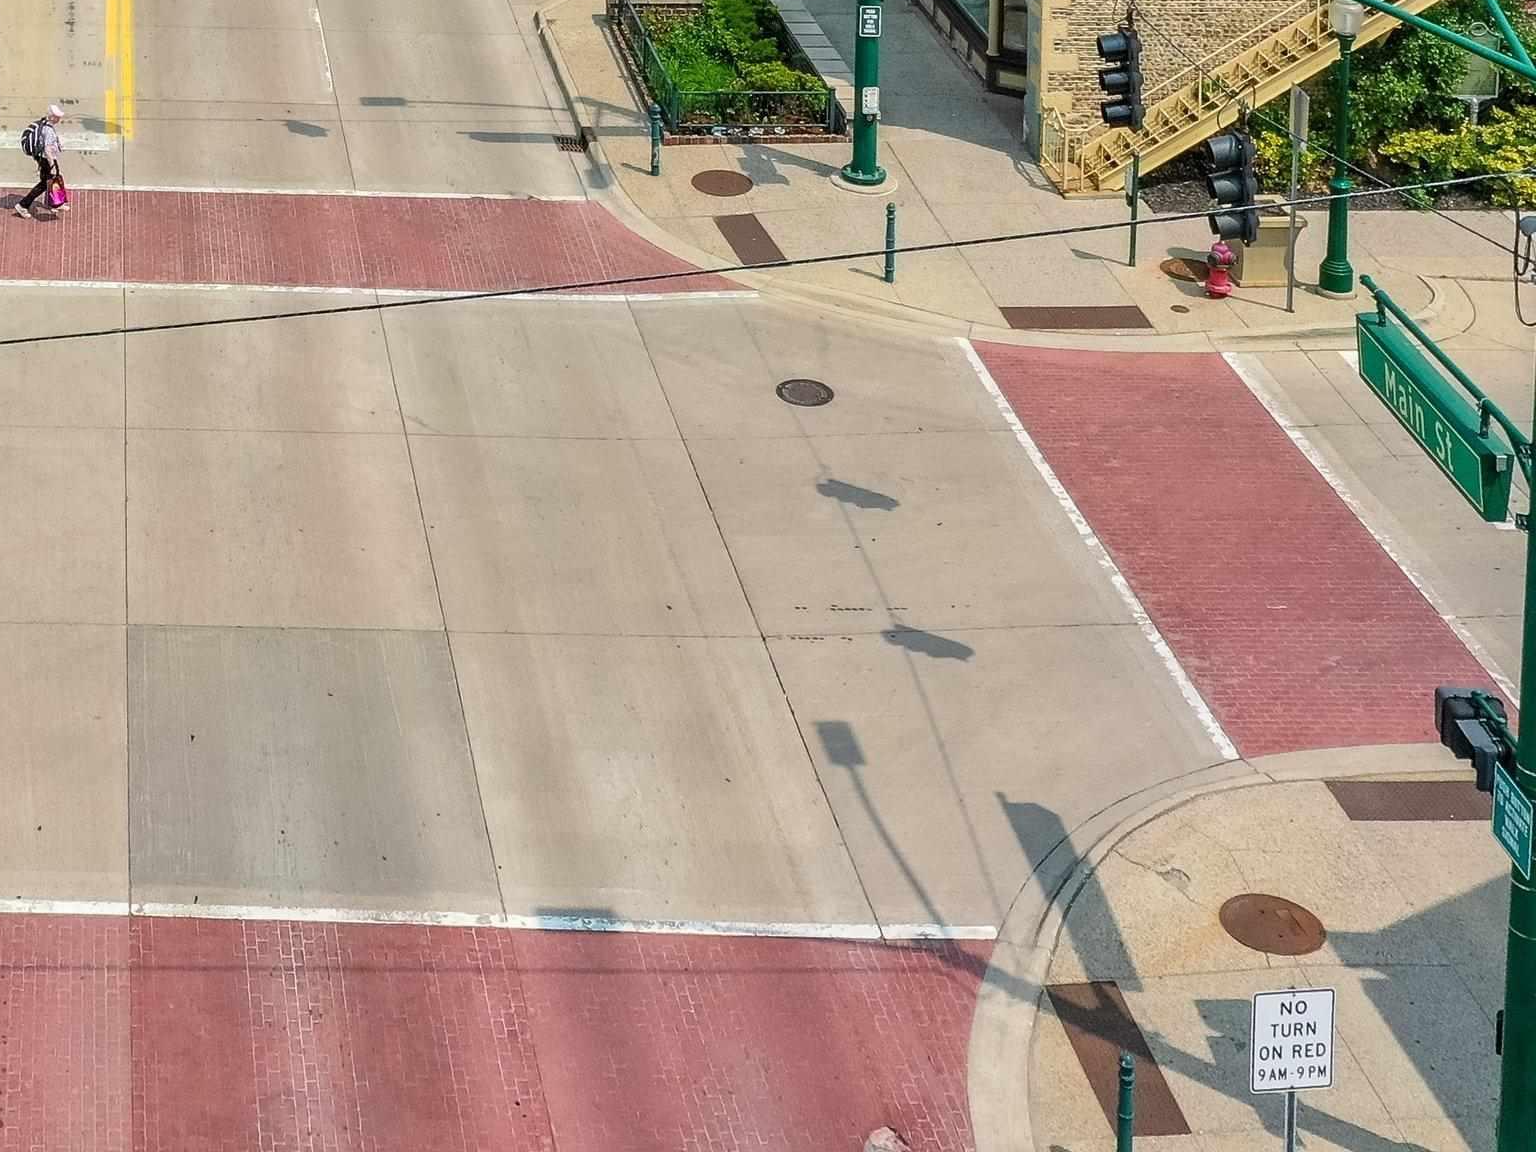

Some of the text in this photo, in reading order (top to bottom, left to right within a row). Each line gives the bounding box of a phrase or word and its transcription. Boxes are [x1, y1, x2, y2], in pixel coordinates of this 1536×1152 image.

[1384, 362, 1454, 472] Main St
[1280, 1001, 1307, 1015] NO
[1271, 1022, 1316, 1038] TURN
[1259, 1043, 1326, 1061] ON RED
